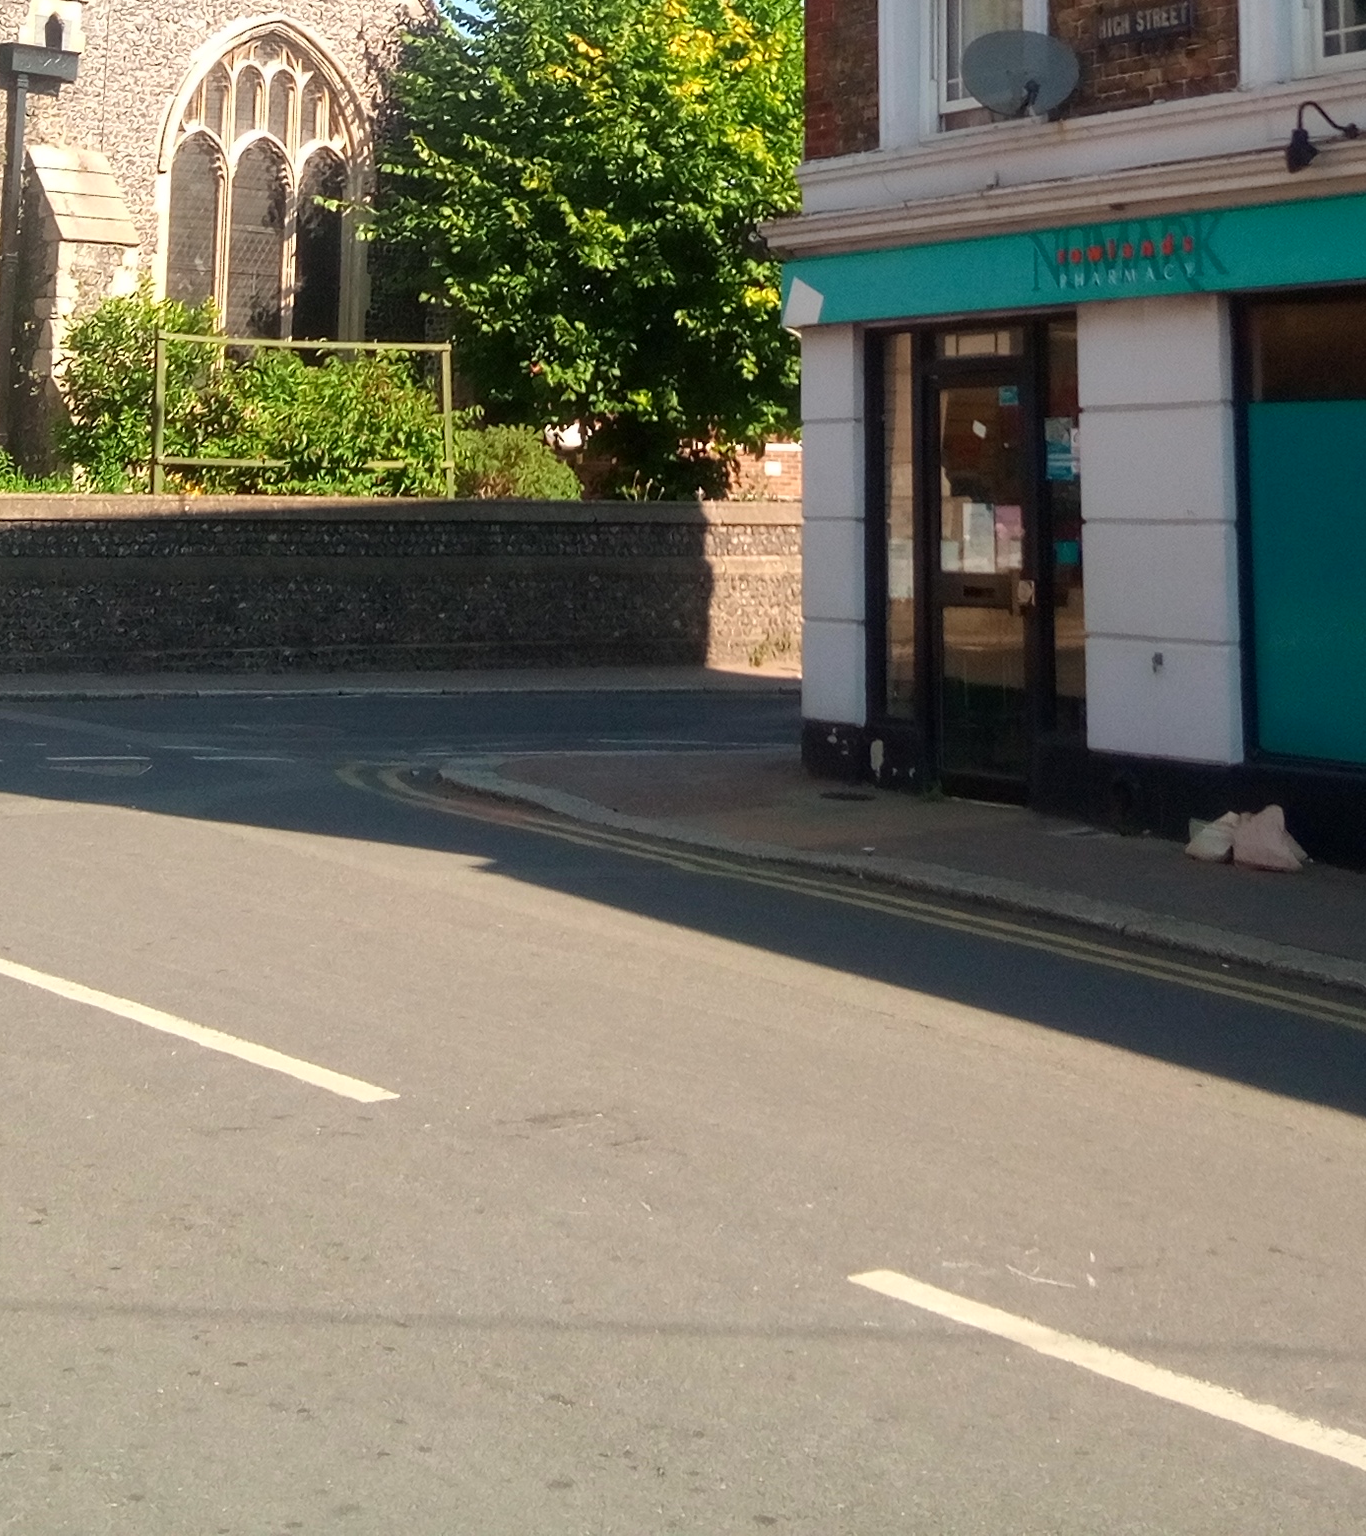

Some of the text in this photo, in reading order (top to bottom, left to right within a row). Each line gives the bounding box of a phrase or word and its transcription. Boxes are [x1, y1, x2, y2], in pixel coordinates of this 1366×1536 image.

[1098, 1, 1188, 40] HIGH STREET
[1057, 233, 1193, 264] rowlands
[1059, 262, 1195, 289] PHARMACY
